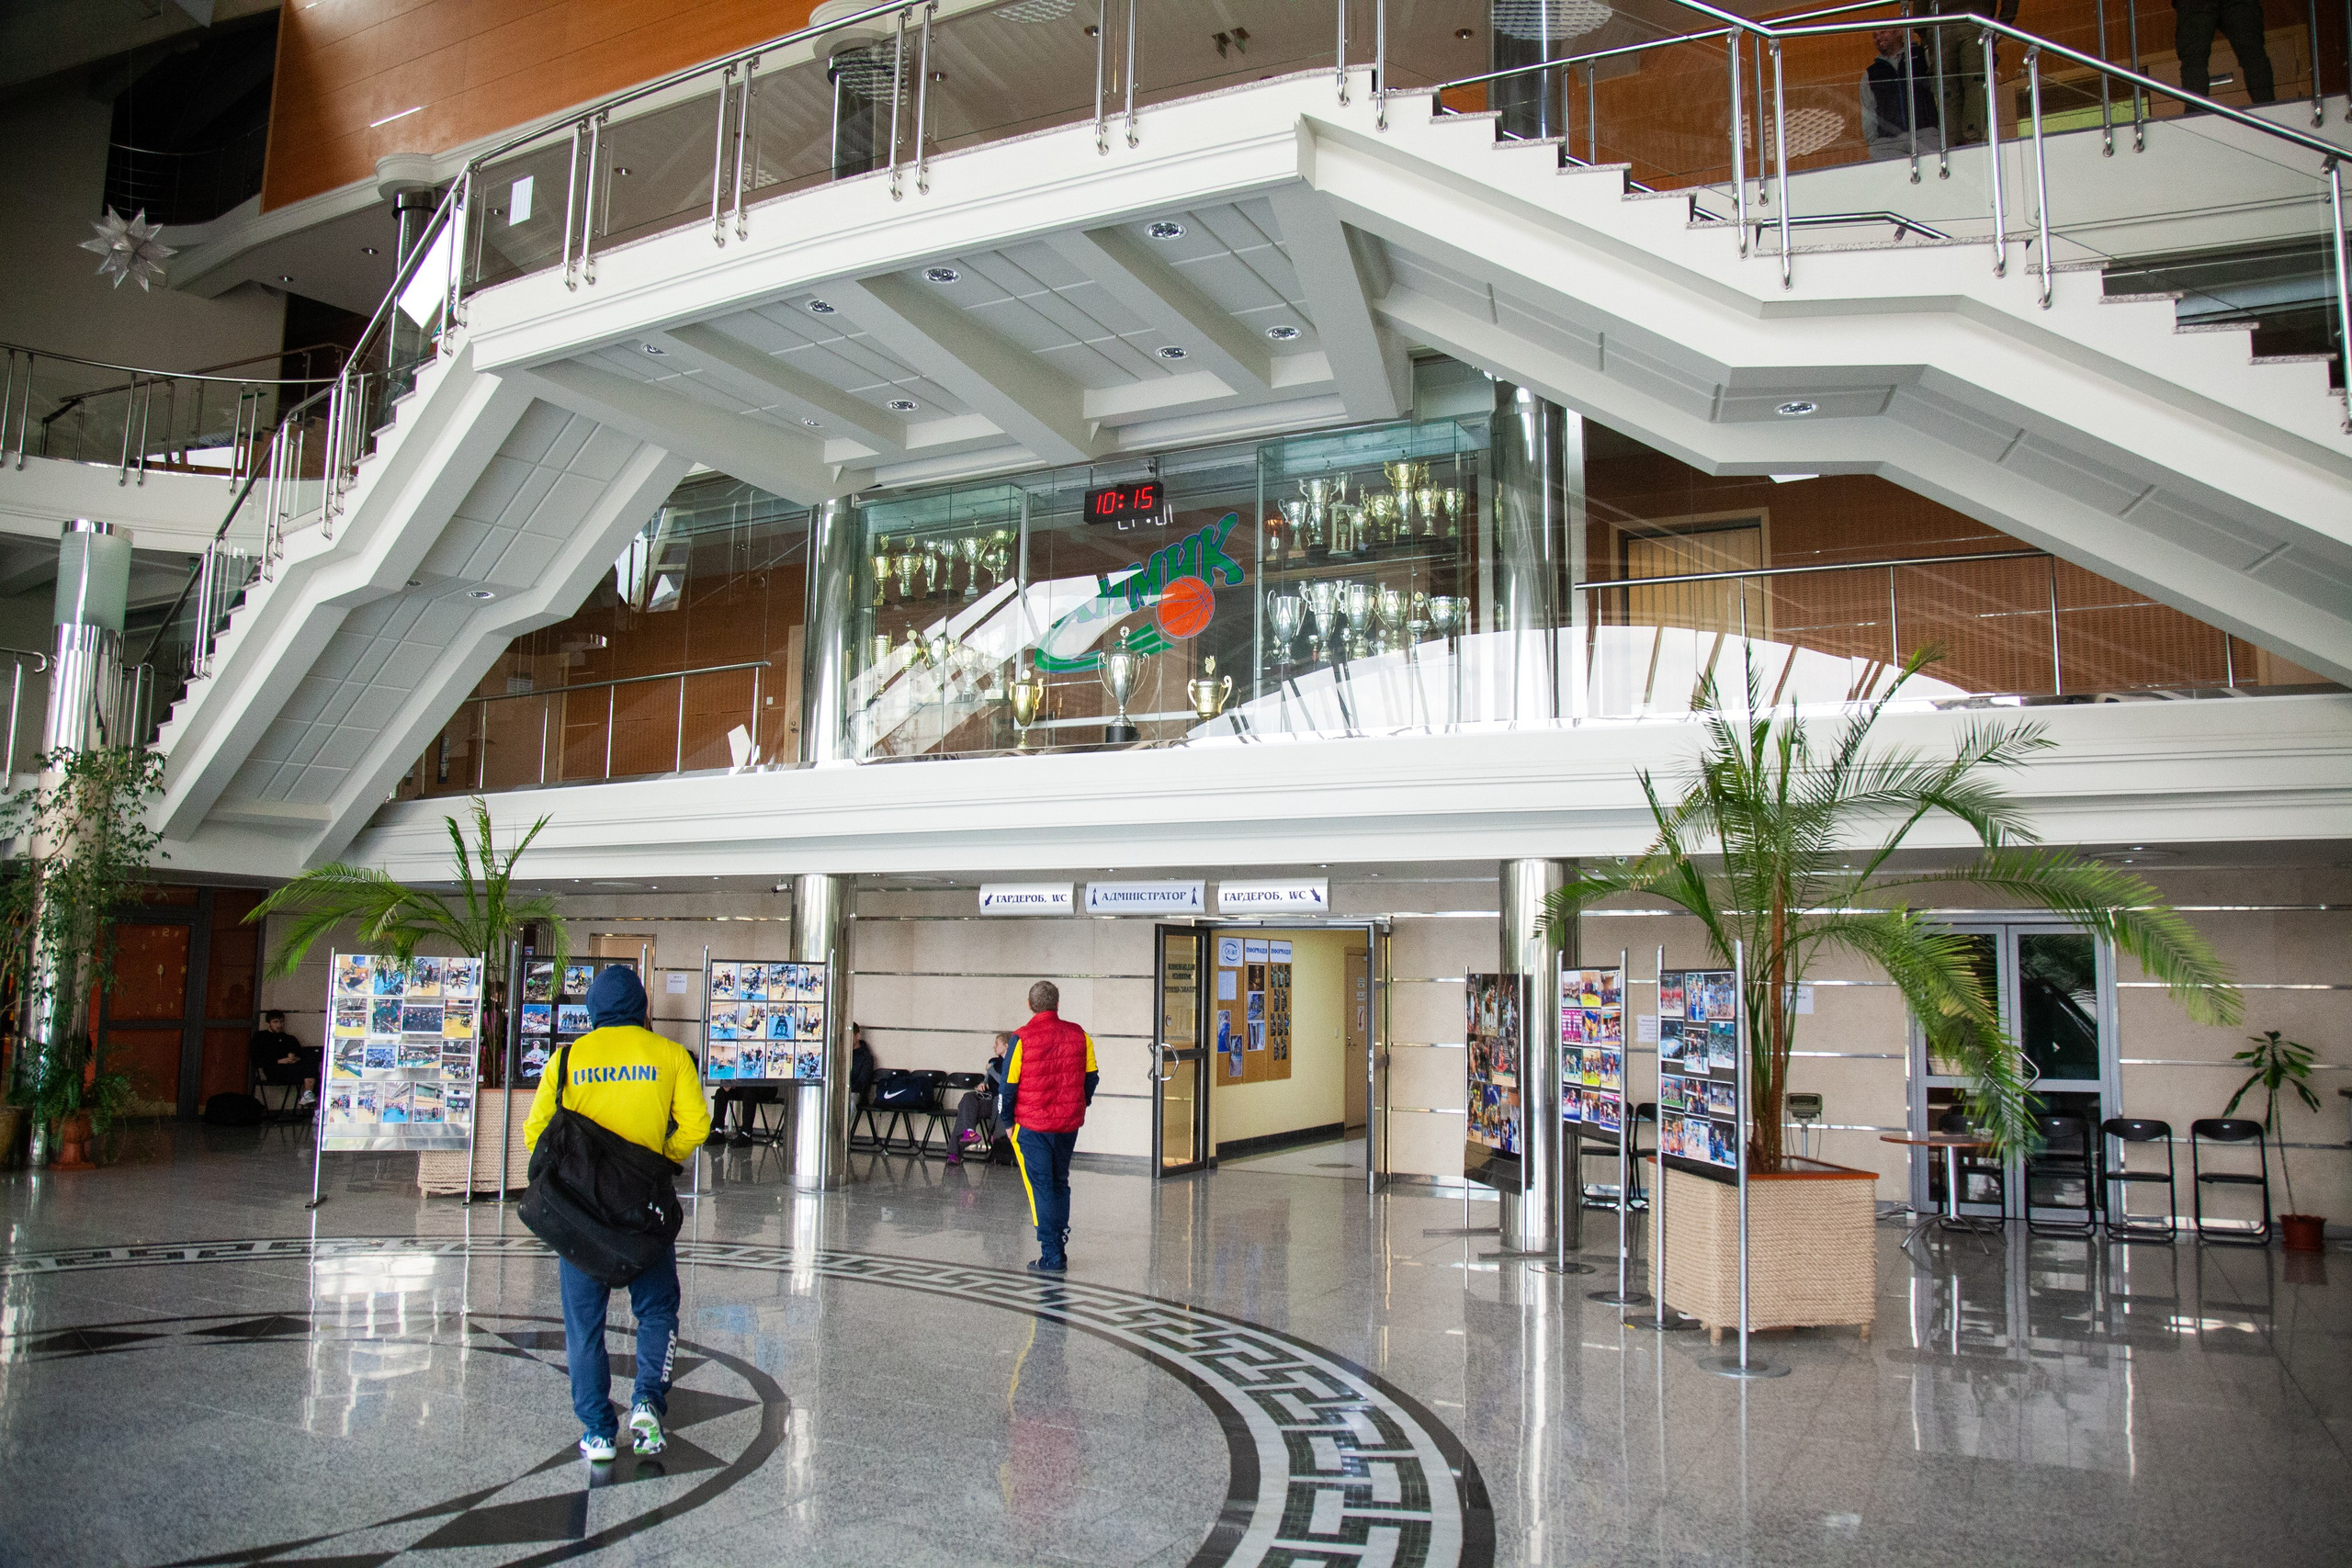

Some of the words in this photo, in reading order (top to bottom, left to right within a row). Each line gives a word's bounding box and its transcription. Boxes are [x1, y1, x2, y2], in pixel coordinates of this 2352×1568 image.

[1096, 486, 1154, 514] 10:15
[996, 894, 1047, 904] ГАРДЕРОБ,
[1052, 894, 1068, 903] WC
[1102, 891, 1187, 902] АДМІНІСТРАТОР
[1224, 891, 1283, 903] ГАРДЕРОБ,
[1288, 890, 1306, 900] WC
